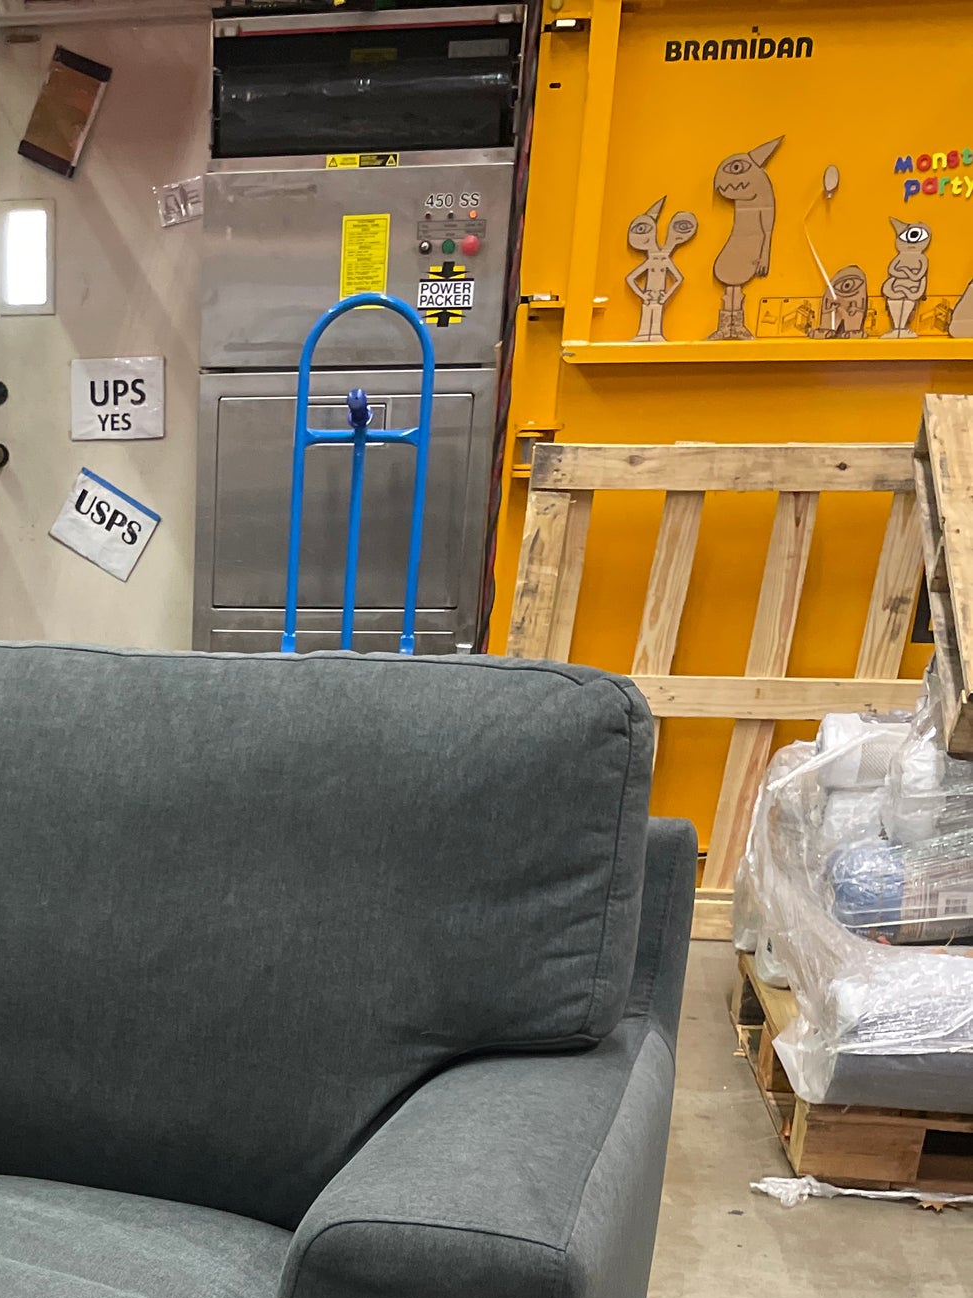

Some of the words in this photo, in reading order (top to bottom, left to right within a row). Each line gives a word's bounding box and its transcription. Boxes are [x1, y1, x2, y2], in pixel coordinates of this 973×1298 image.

[665, 26, 813, 62] BRAMIDAN
[425, 193, 454, 208] 450
[459, 192, 481, 208] SS
[420, 282, 472, 295] POWER
[419, 294, 471, 307] PACKER
[89, 378, 146, 407] UPS
[97, 412, 132, 432] YES
[74, 488, 142, 546] USPS
